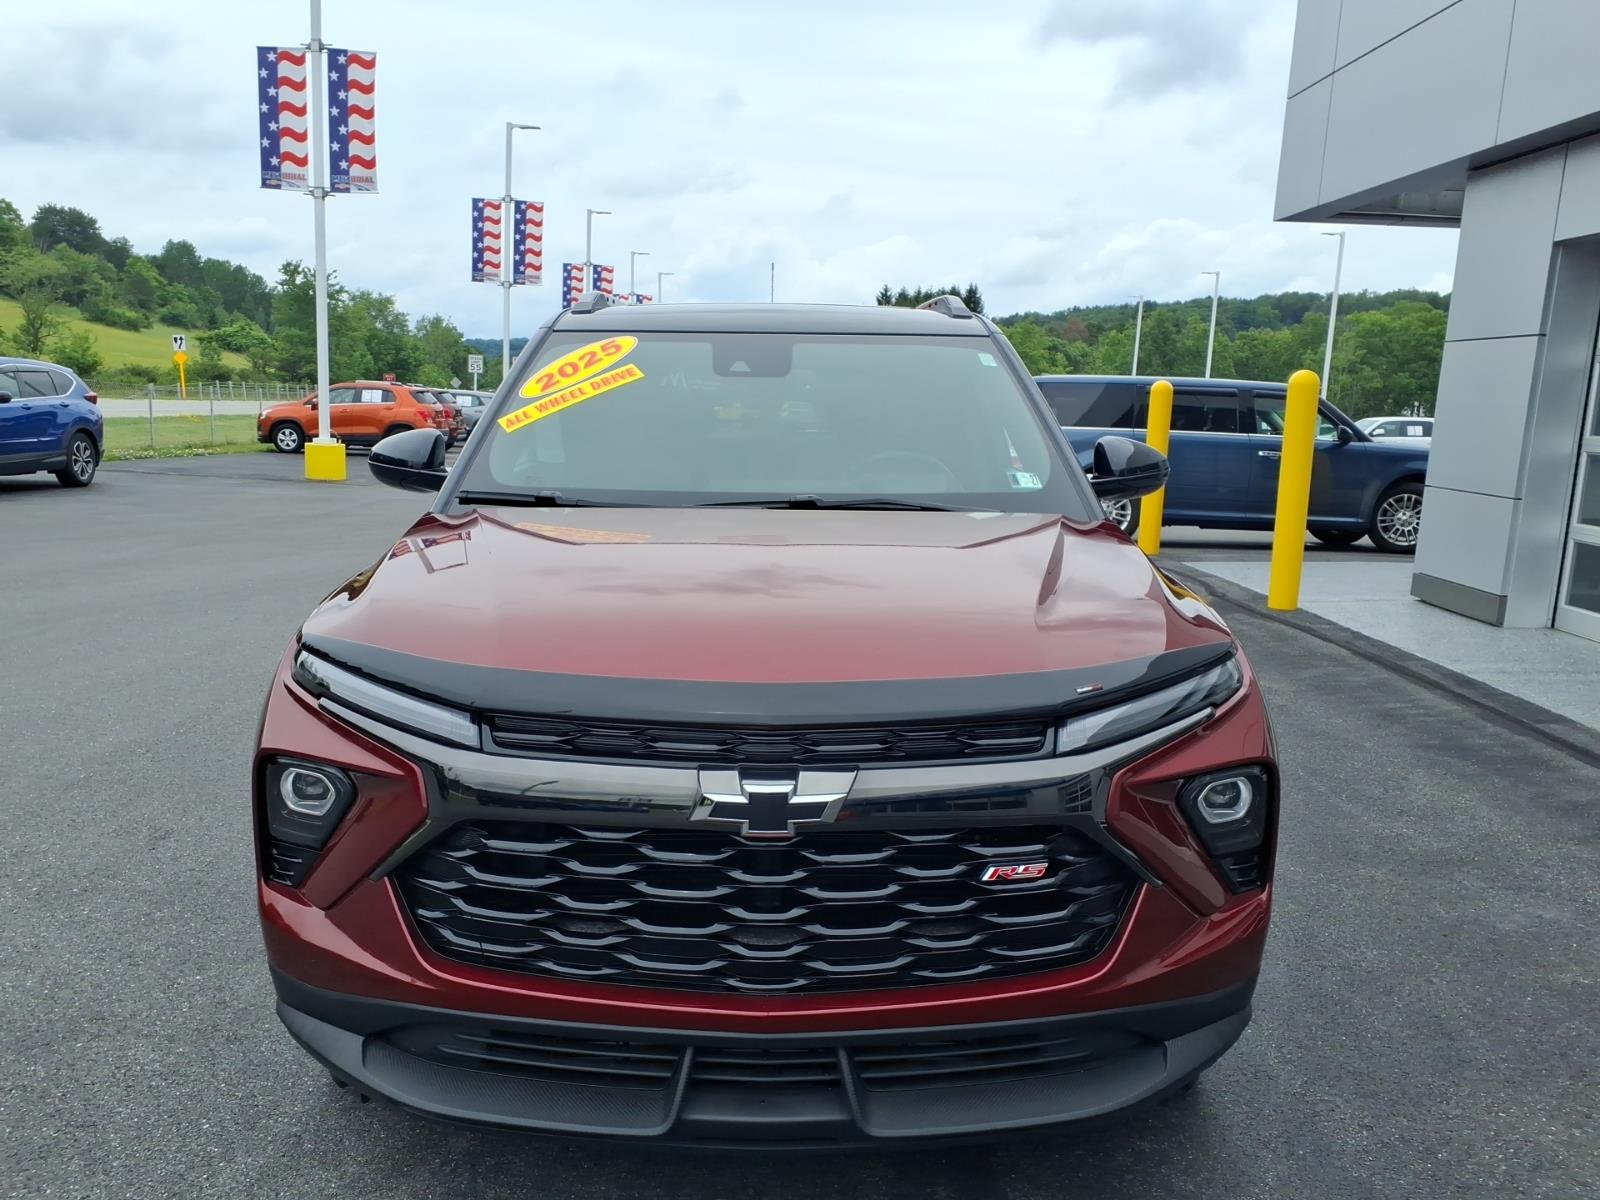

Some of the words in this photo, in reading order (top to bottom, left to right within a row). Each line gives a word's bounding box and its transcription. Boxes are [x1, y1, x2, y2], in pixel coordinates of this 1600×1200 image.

[470, 363, 481, 371] 55
[535, 339, 623, 392] 2025
[505, 410, 533, 429] ALL
[534, 386, 587, 414] WHEEL
[590, 366, 638, 391] DRIVE
[982, 863, 1048, 880] RS
